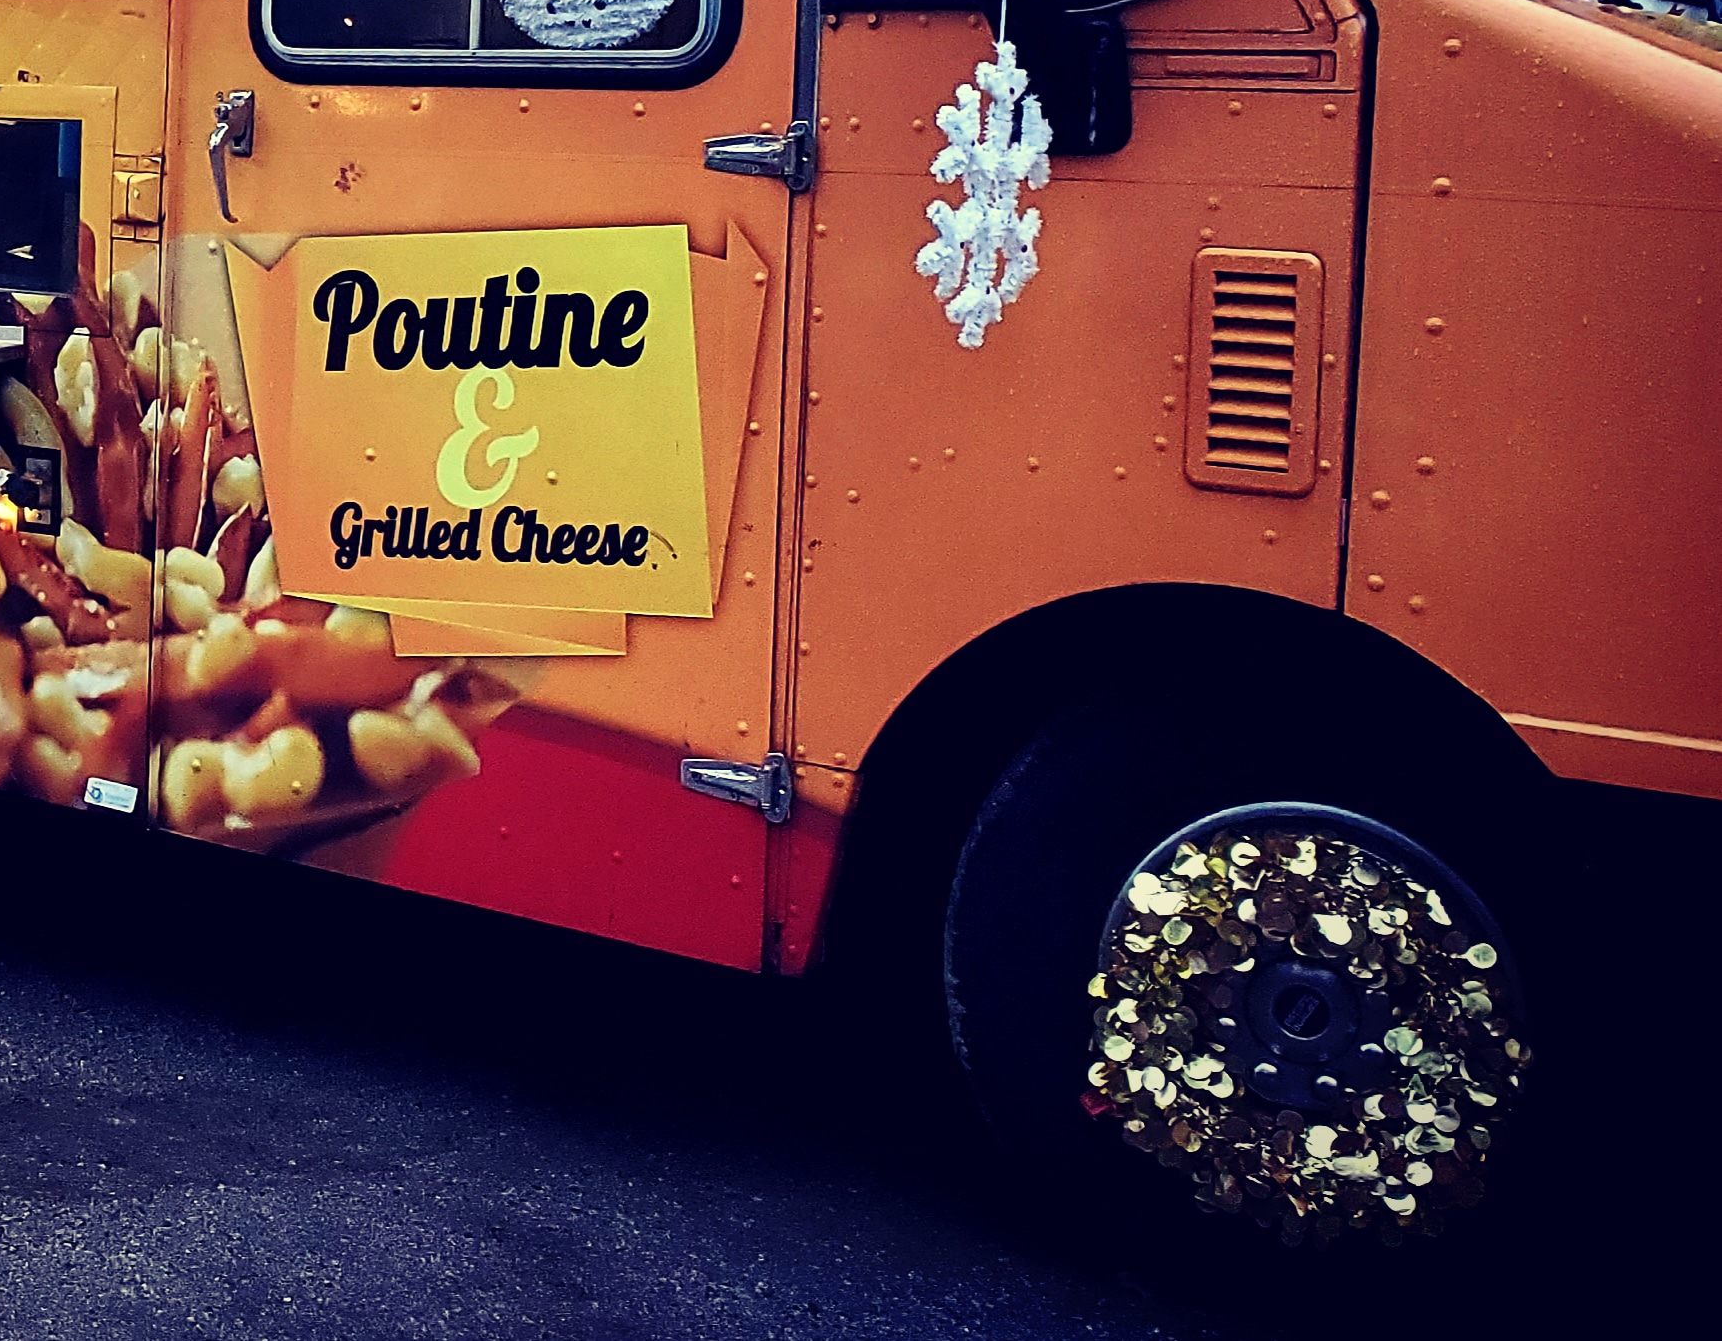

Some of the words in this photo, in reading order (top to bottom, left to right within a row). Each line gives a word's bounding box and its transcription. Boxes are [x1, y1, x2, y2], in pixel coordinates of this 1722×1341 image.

[312, 266, 649, 372] Poutine
[435, 366, 540, 509] &
[329, 500, 482, 570] Grilled
[491, 505, 649, 568] Cheese
